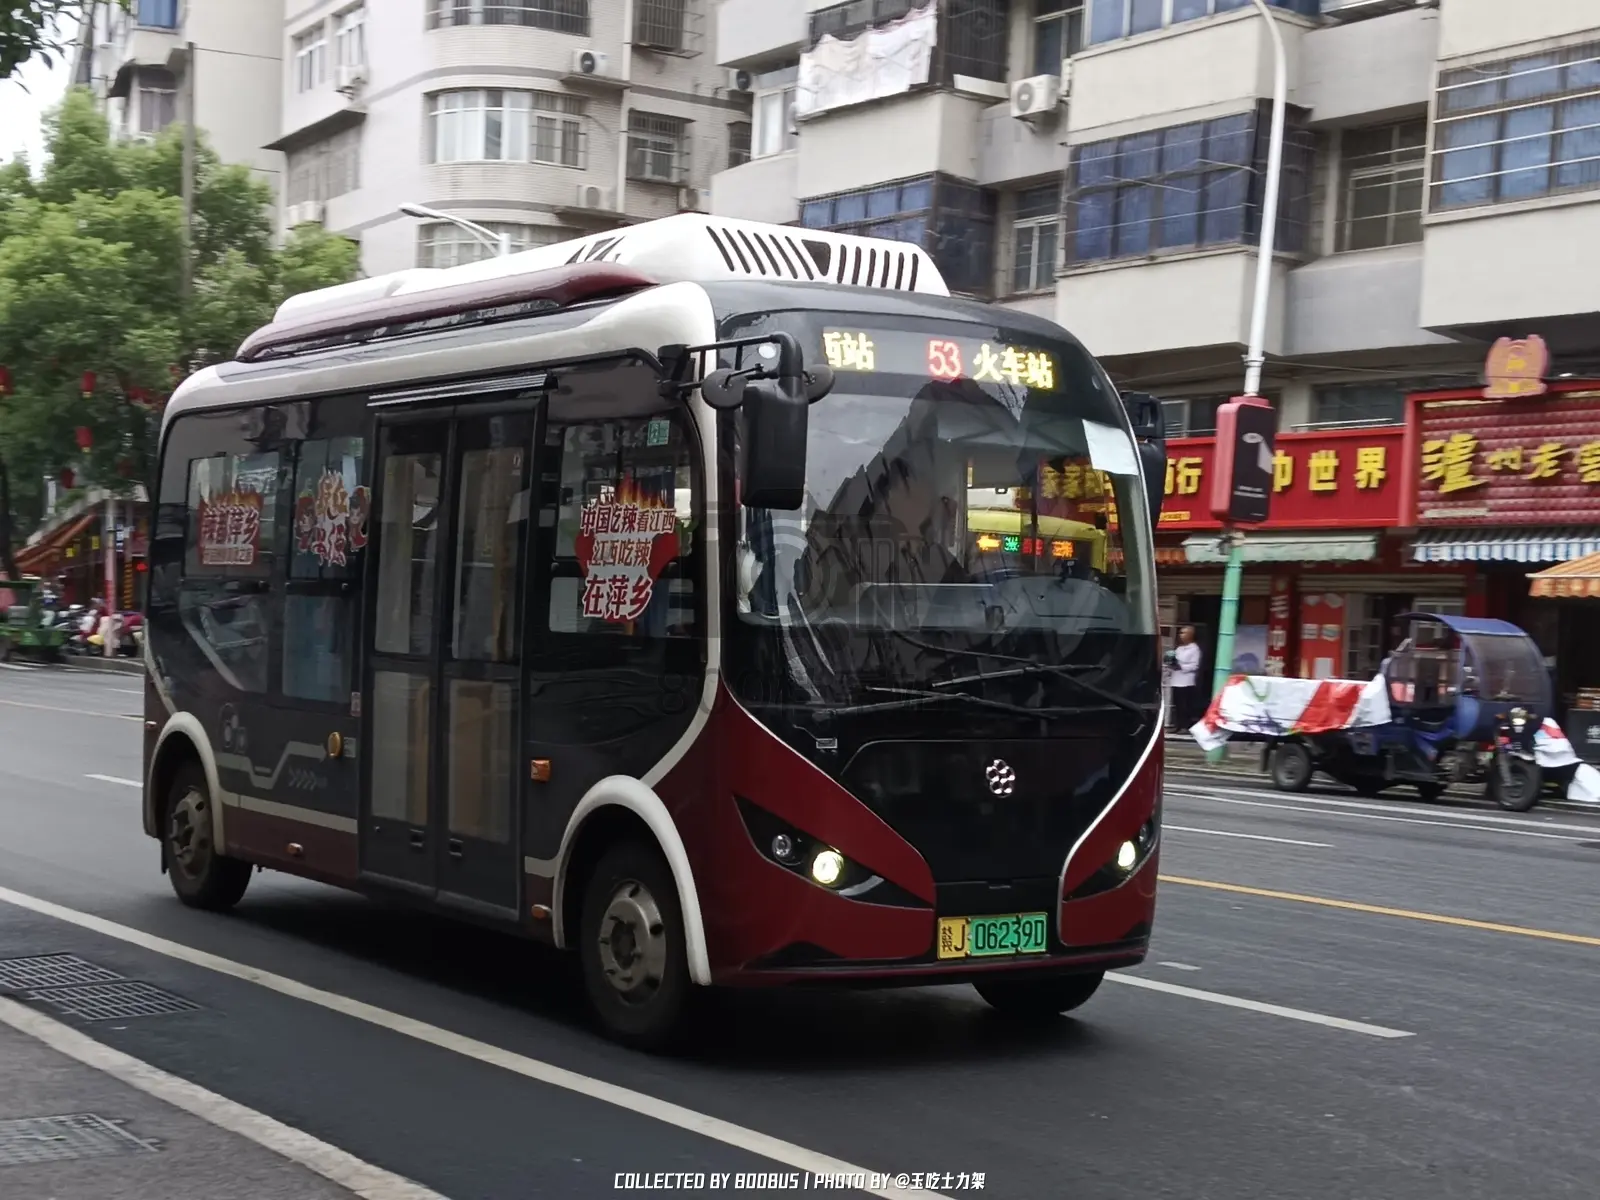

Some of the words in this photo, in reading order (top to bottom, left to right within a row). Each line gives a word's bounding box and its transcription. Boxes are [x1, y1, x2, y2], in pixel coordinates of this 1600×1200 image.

[928, 340, 962, 378] 53
[972, 343, 1054, 390] 火车站
[588, 538, 653, 567] 江西吃辣
[582, 574, 653, 619] 在萍乡
[974, 919, 1046, 950] 06239D
